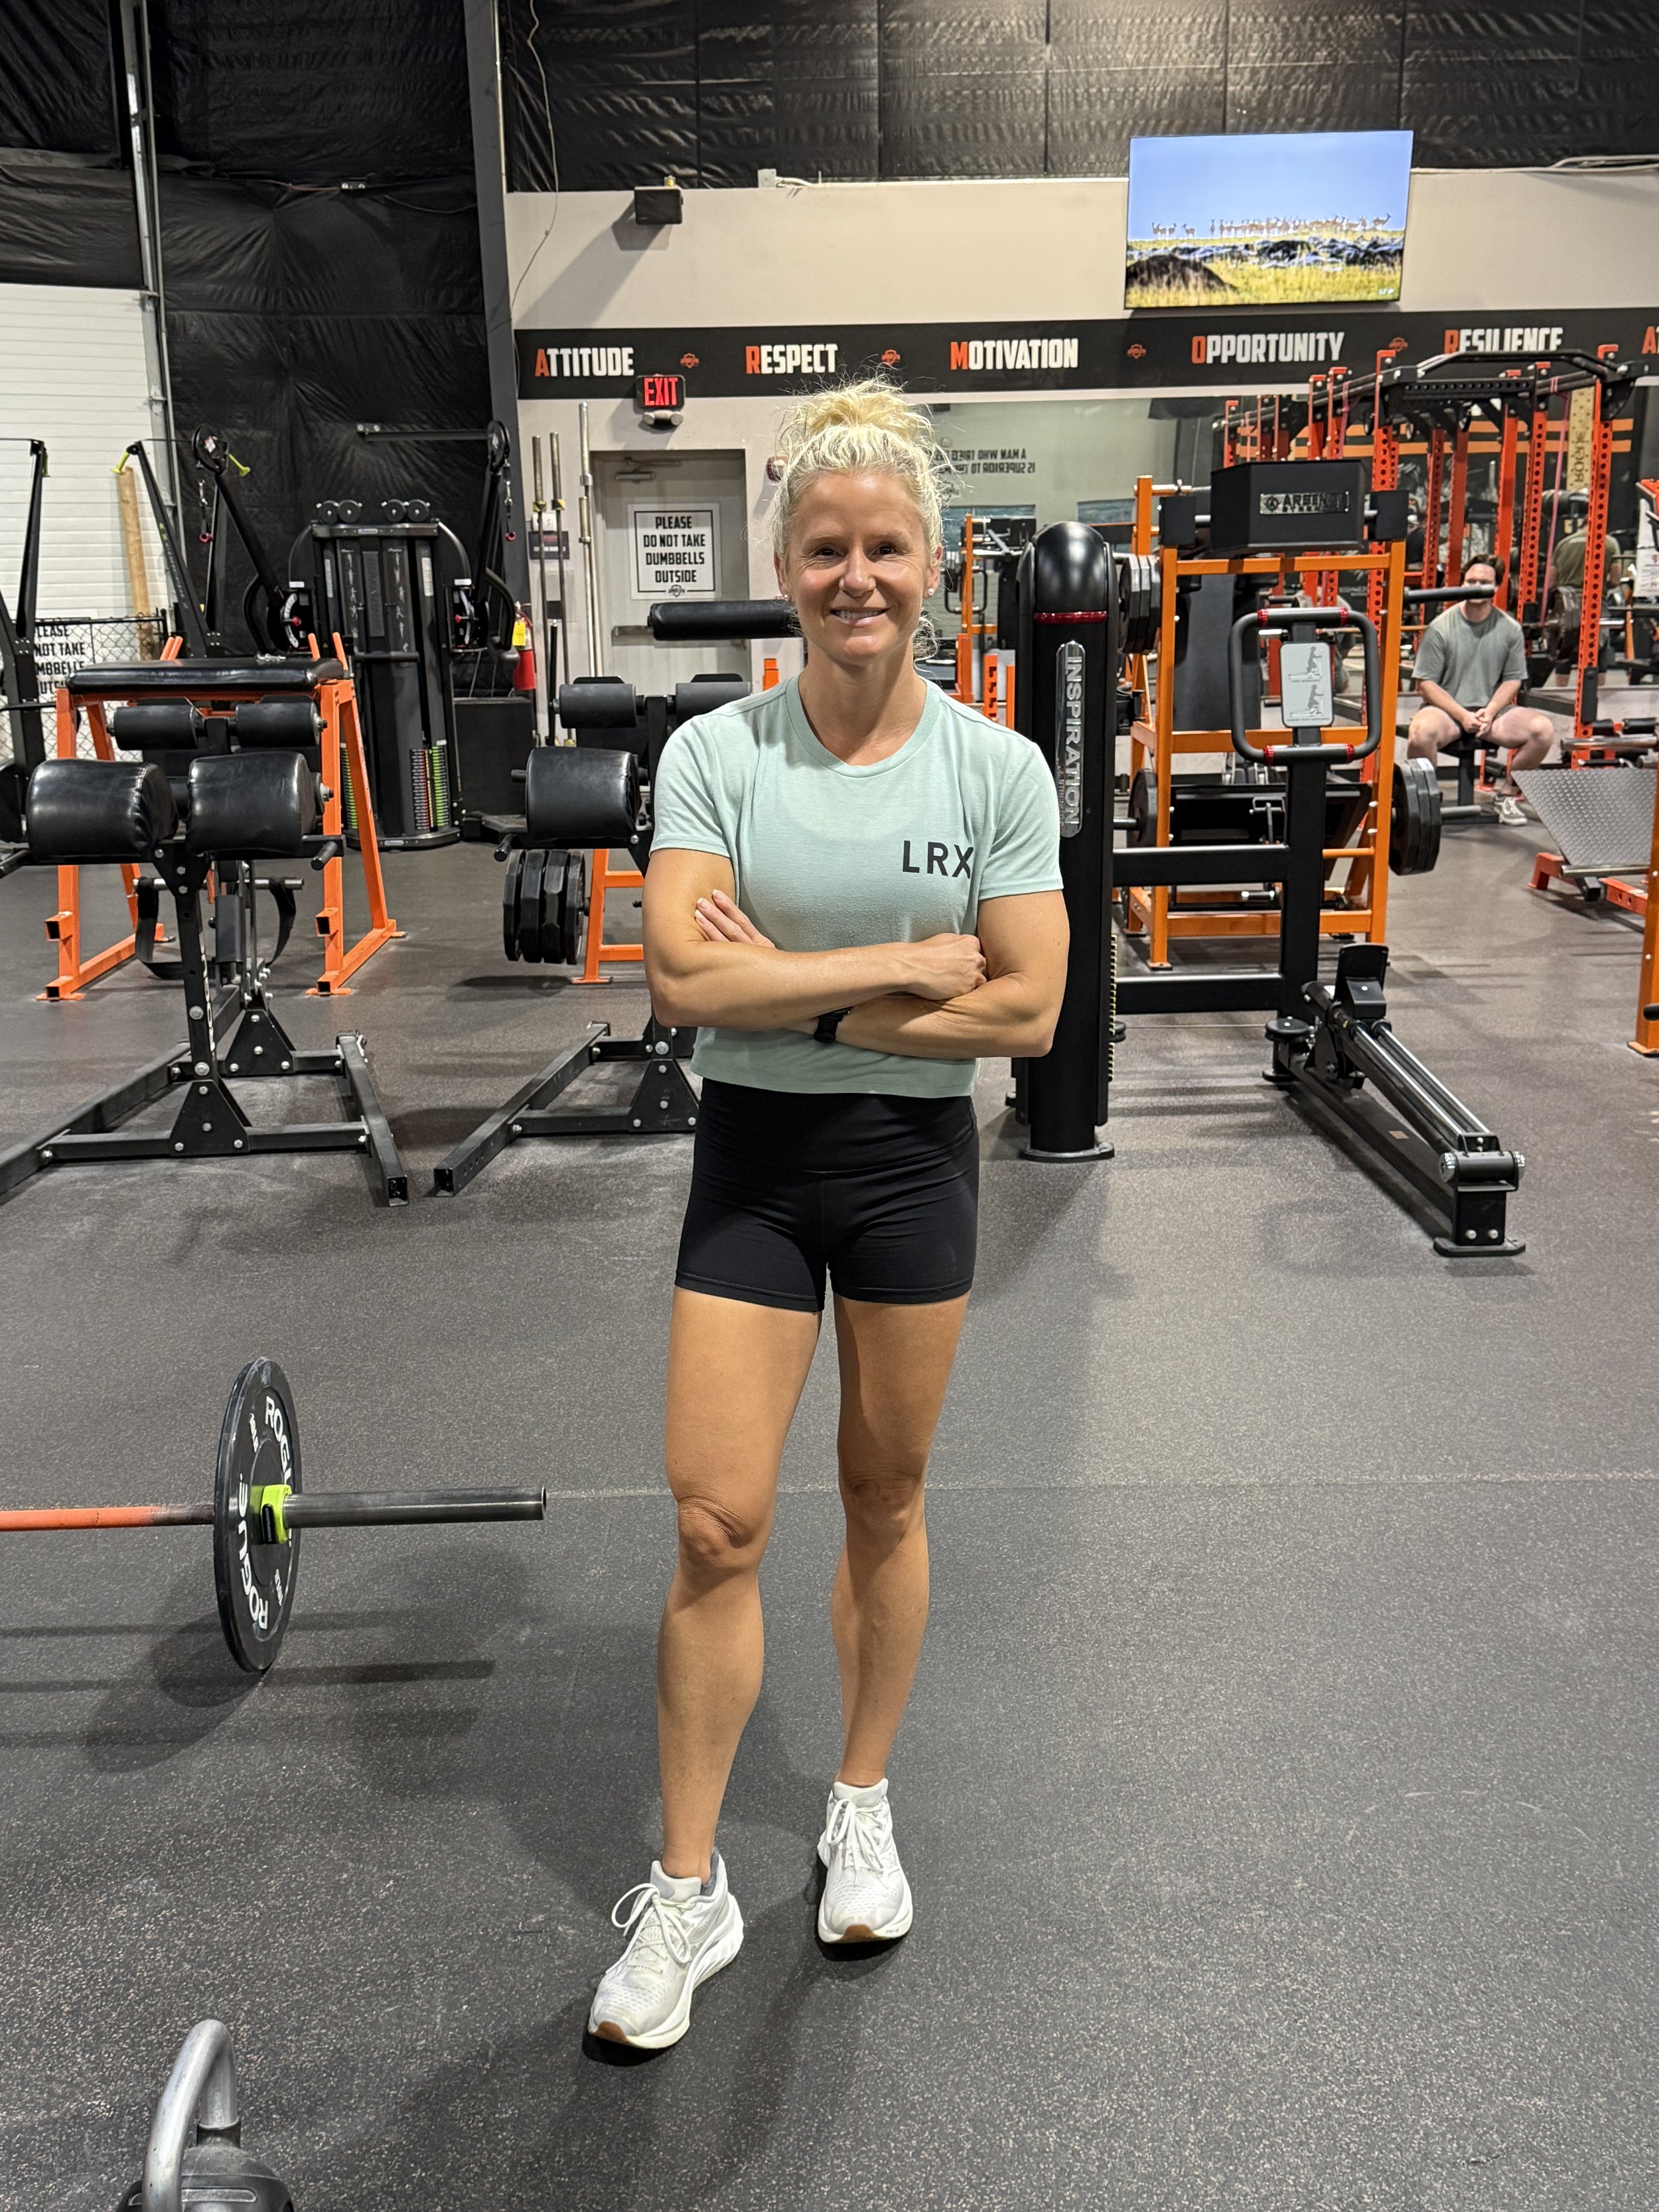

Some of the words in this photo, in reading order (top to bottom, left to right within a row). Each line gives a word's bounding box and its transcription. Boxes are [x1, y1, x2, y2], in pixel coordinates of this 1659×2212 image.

[535, 347, 634, 377] ATTITUDE
[745, 343, 838, 374] RESPECT
[950, 338, 1078, 370] MOTIVATION
[1191, 332, 1344, 364] OPPORTUNITY
[643, 376, 678, 407] EXIT
[656, 516, 692, 529] PLEASE
[644, 534, 657, 548] DO
[659, 534, 679, 547] NOT
[682, 534, 705, 547] TAKE
[646, 552, 705, 565] DUMBBELLS
[655, 569, 697, 583] OUTSIDE
[36, 625, 70, 637] LEASE
[58, 642, 86, 656] TAKE
[1065, 655, 1084, 825] INSPIRATION
[902, 840, 974, 879] LRX
